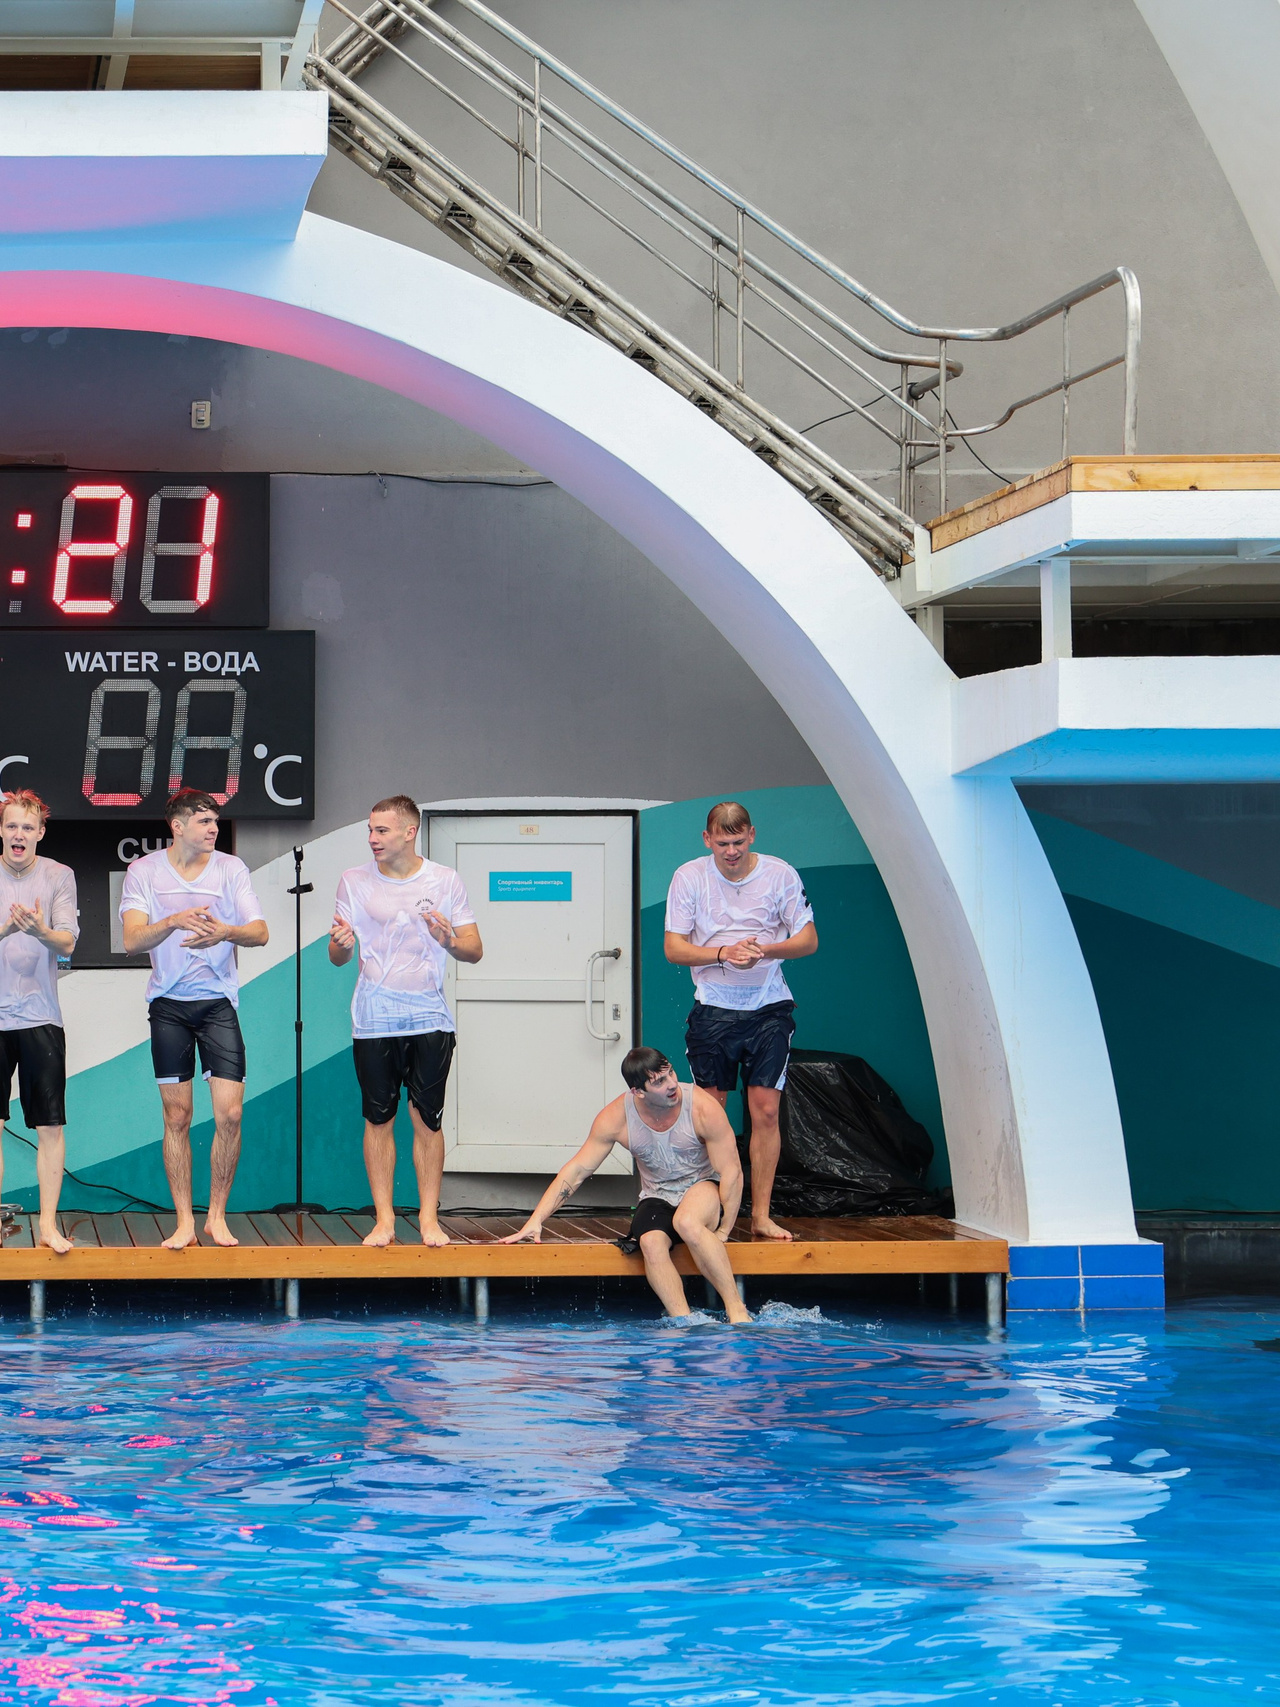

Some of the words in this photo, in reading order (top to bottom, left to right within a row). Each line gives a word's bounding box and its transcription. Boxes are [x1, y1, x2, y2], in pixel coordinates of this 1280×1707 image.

[64, 651, 159, 673] WATER
[183, 651, 260, 675] ВОДА
[117, 837, 174, 863] СЧ
